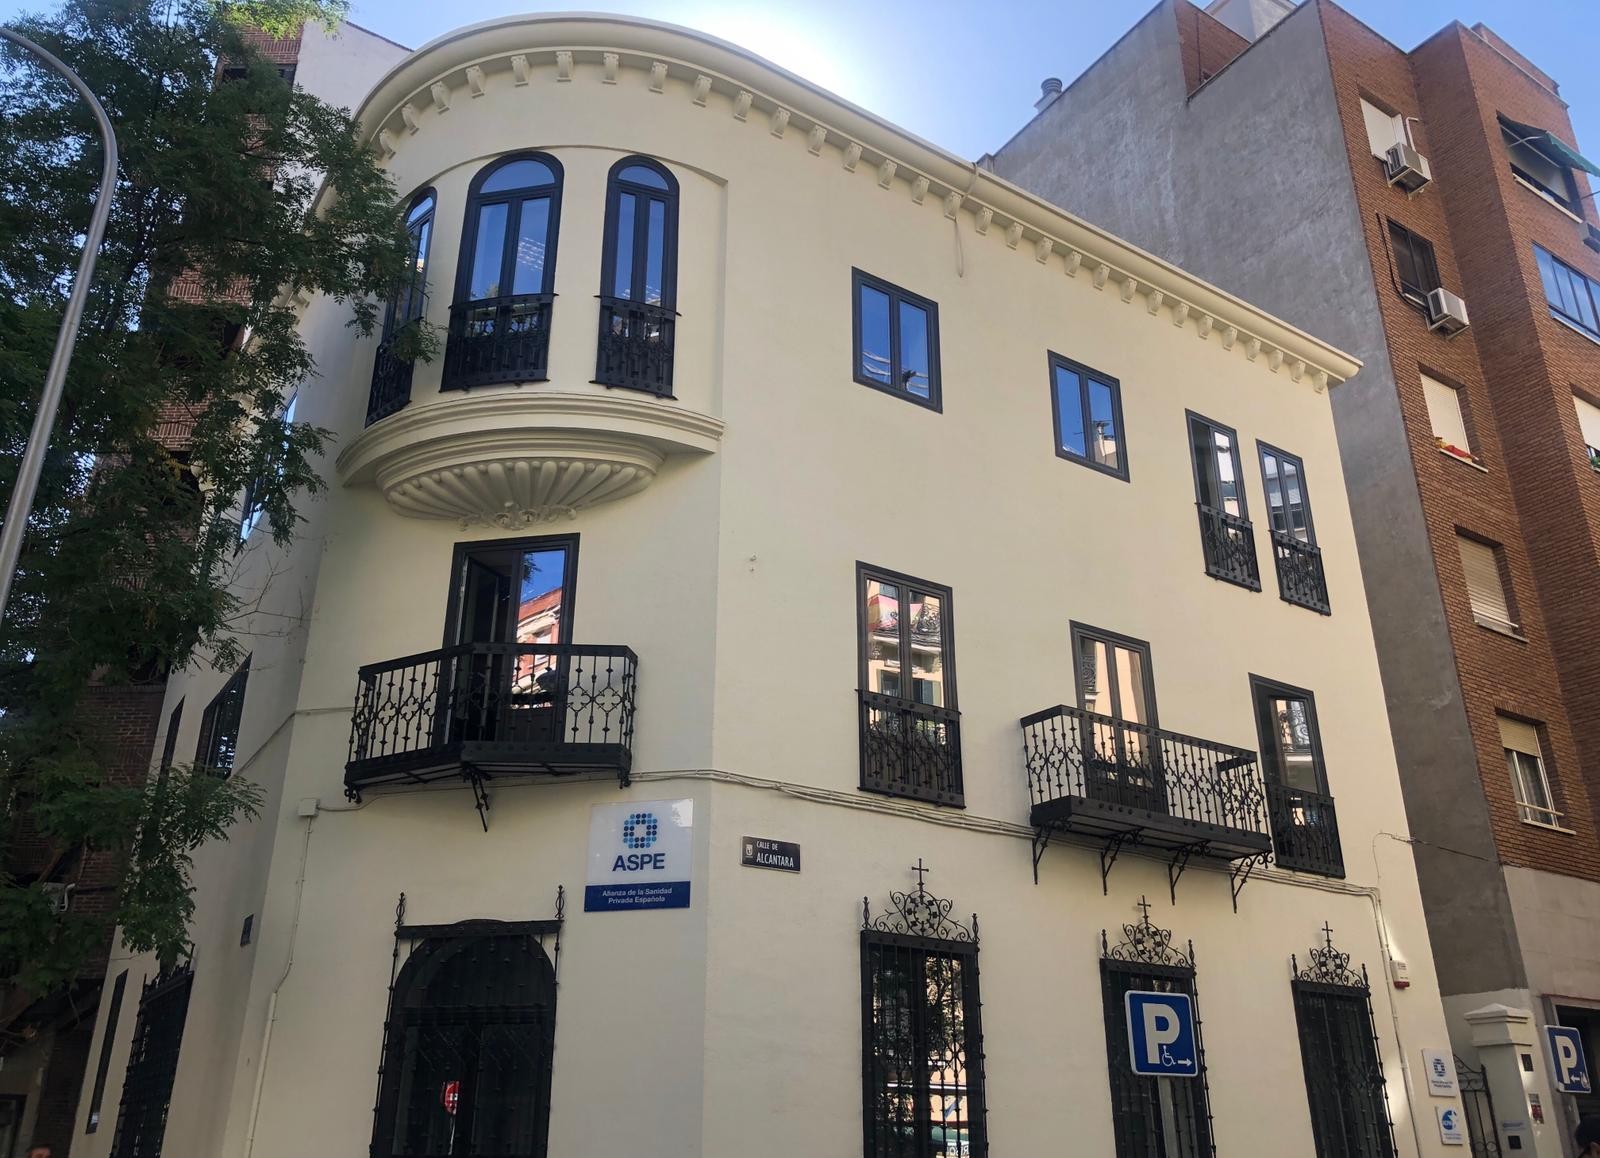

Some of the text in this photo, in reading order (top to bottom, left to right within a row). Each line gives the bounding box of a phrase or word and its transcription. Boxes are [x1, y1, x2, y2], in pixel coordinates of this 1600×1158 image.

[756, 840, 779, 851] CALLE DE
[612, 853, 666, 872] ASPE
[756, 852, 794, 868] ALCANTARA
[634, 895, 666, 904] Española
[637, 888, 644, 896] la
[645, 887, 672, 895] Sanidad
[1142, 1003, 1180, 1064] P
[1555, 1035, 1578, 1084] P
